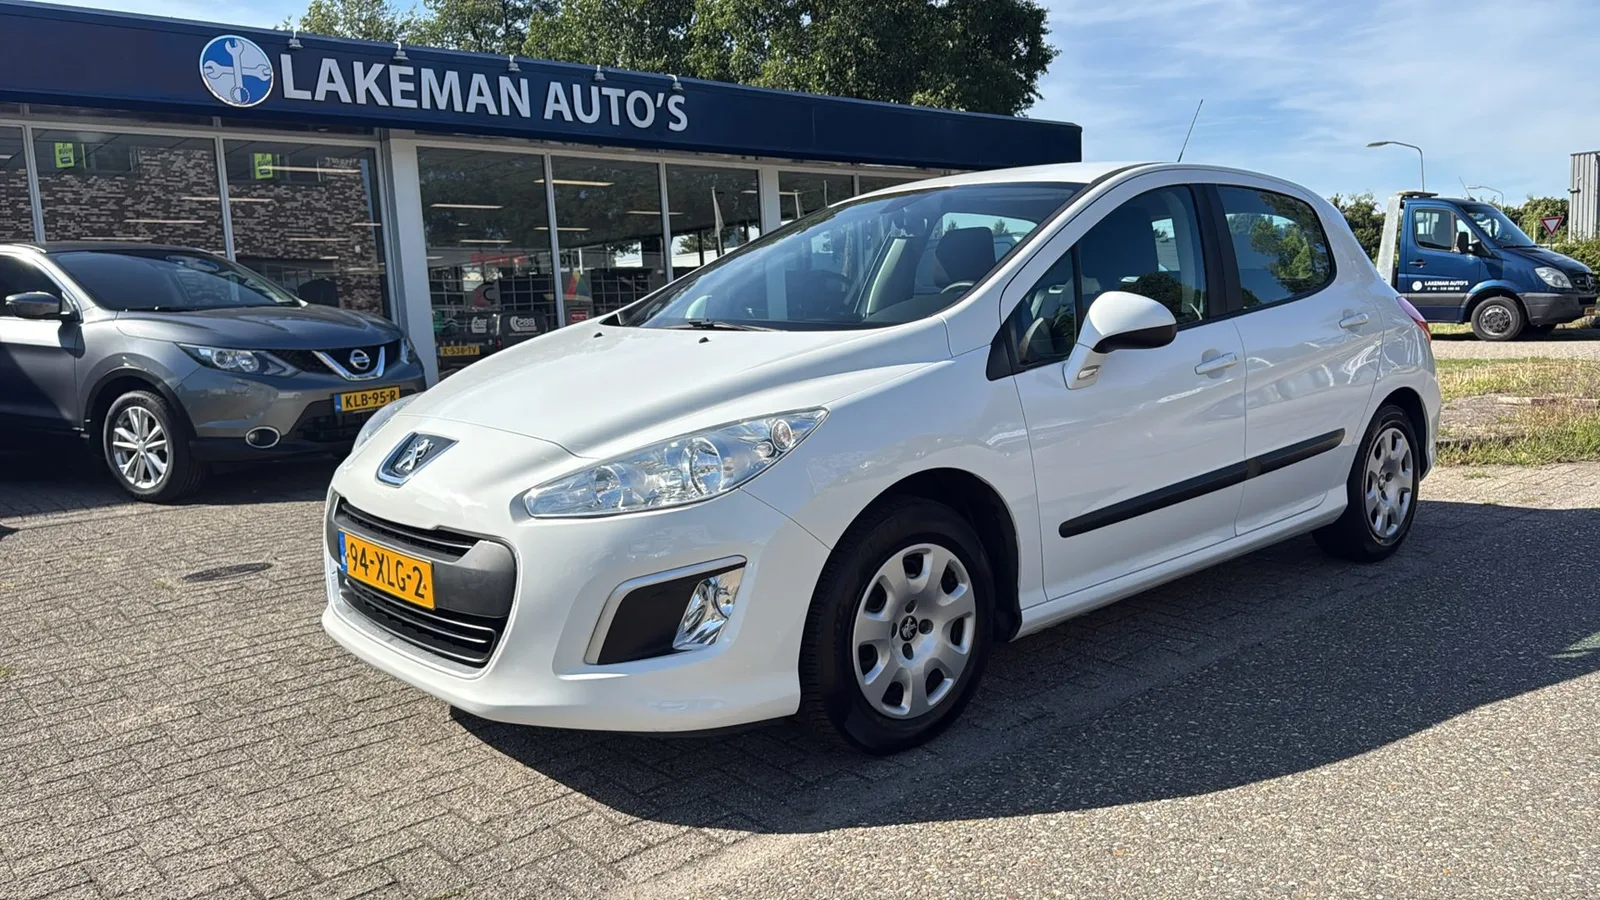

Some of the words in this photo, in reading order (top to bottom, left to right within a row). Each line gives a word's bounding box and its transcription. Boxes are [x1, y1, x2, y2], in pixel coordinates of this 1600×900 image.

[280, 54, 531, 119] LAKEMAN
[543, 82, 689, 133] AUTO'S
[345, 389, 396, 409] KLB-95-R
[349, 542, 425, 600] 94-XLG-2
